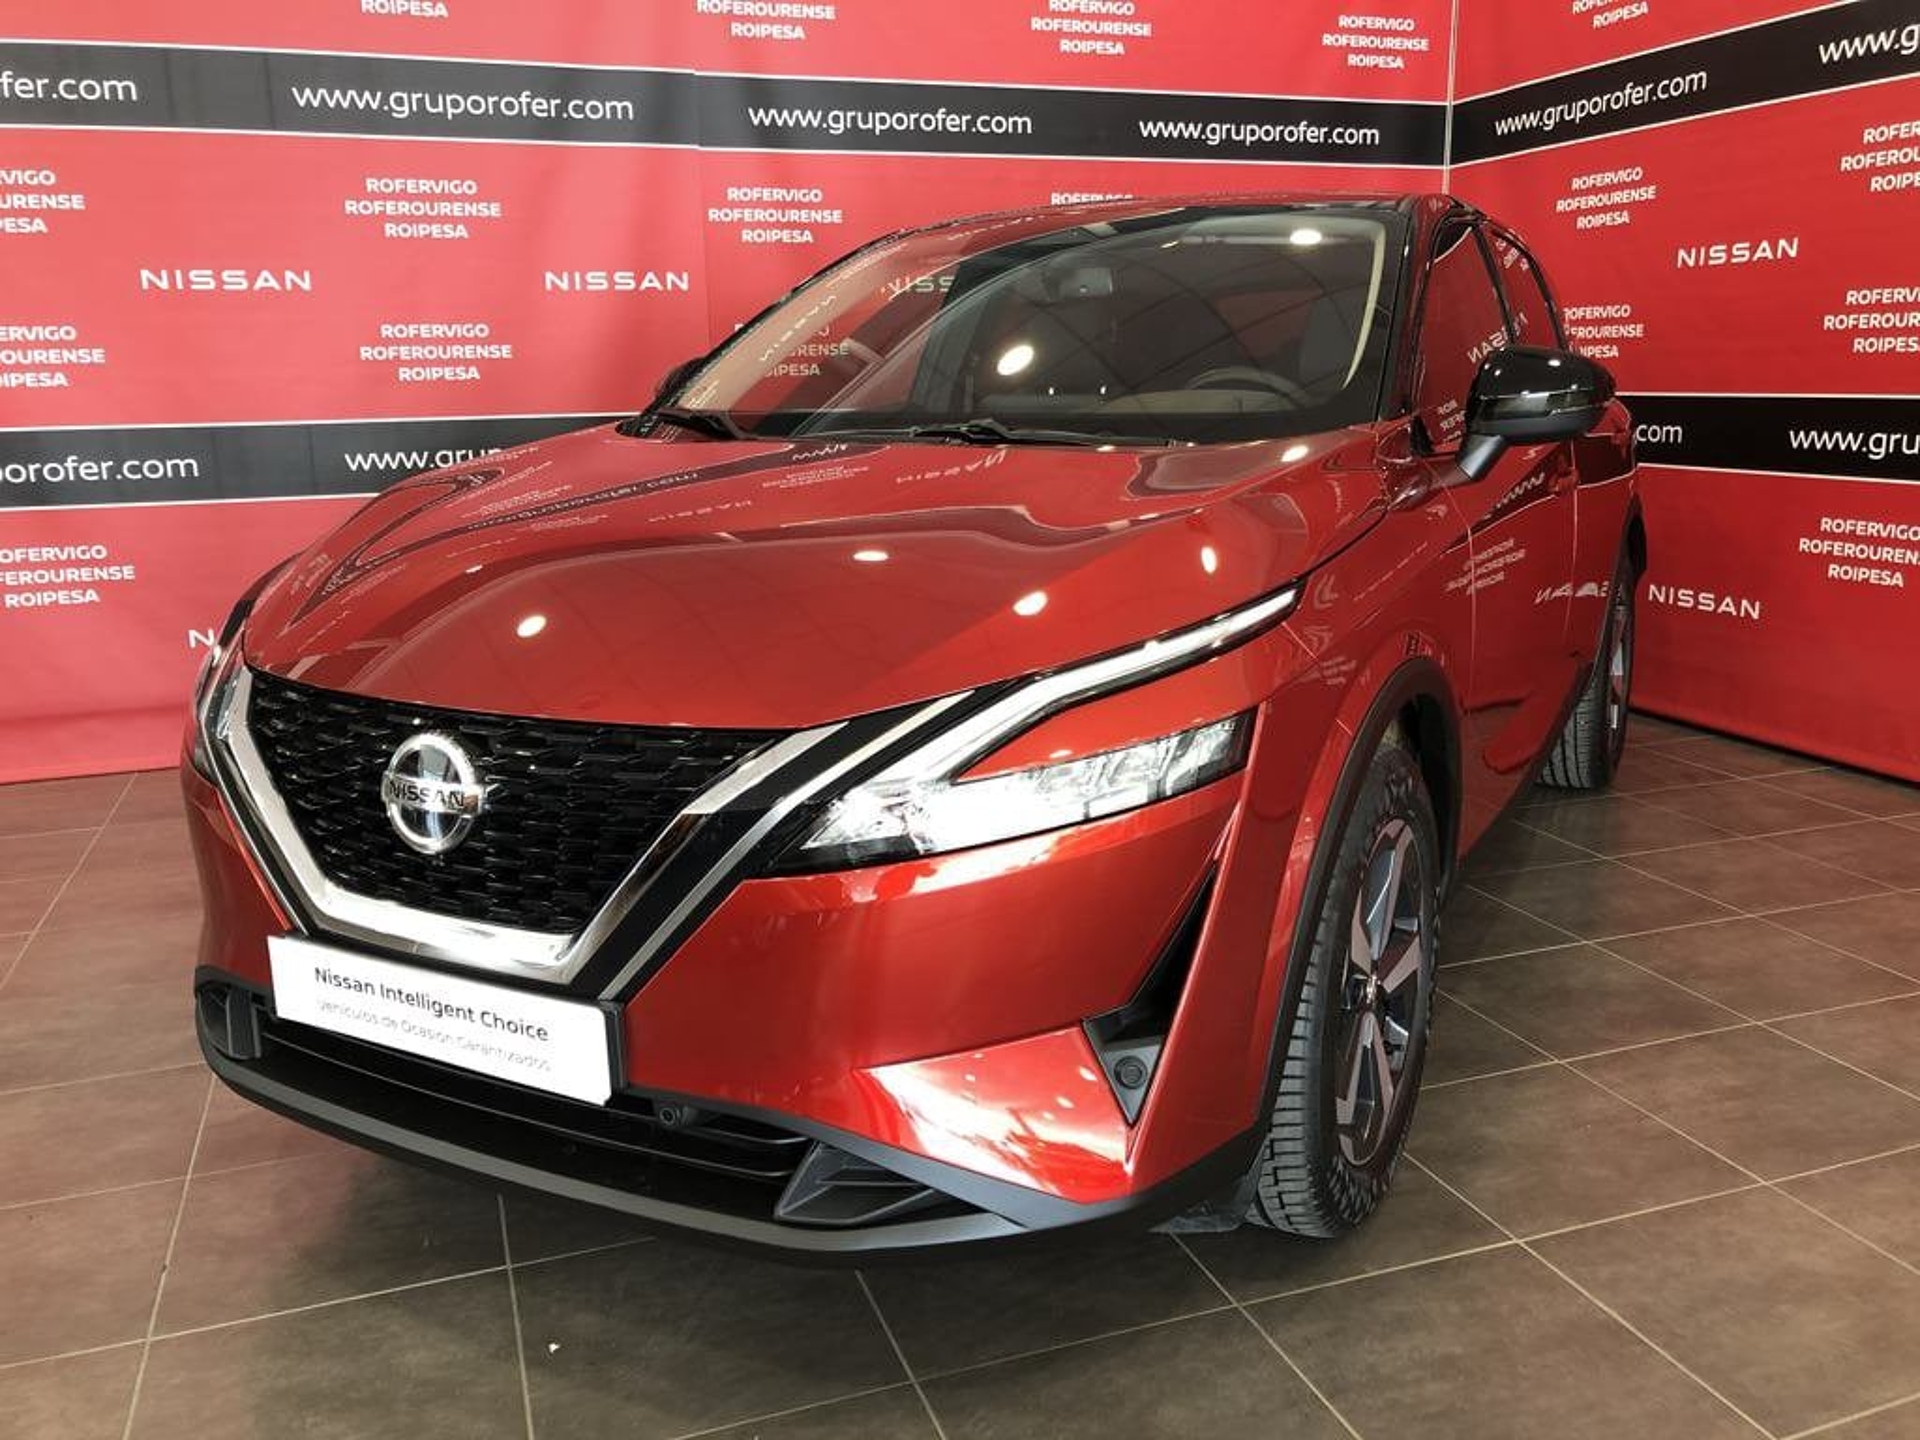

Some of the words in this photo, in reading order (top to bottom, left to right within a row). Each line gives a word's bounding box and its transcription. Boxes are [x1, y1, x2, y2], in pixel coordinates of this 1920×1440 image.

[360, 0, 448, 17] ROIPESA
[697, 0, 835, 20] ROFEROURENSE
[1050, 0, 1134, 15] ROFERVIGO
[1593, 1, 1649, 30] ROIPESA
[731, 22, 805, 39] ROIPESA
[1031, 17, 1151, 36] ROFEROURENSE
[1338, 14, 1414, 31] ROFERVIGO
[1060, 39, 1125, 55] ROIPESA
[1322, 33, 1429, 51] ROFEROURENSE
[1347, 54, 1404, 68] ROIPESA
[292, 83, 634, 121] www.gruporofer.com
[1494, 70, 1707, 137] www.gruporofer.com
[748, 105, 1032, 136] www.gruporofer.com
[1139, 121, 1379, 146] www.gruporofer.com
[0, 170, 56, 185] VIGO
[366, 177, 477, 195] ROFERVIGO
[1571, 166, 1643, 191] ROFERVIGO
[727, 186, 823, 203] ROFERVIGO
[1556, 185, 1656, 213] ROFEROURENSE
[344, 199, 501, 218] ROFEROURENSE
[708, 207, 842, 224] ROFEROURENSE
[0, 217, 48, 233] ESA
[1576, 209, 1630, 231] ROIPESA
[384, 221, 468, 239] ROIPESA
[741, 228, 814, 244] ROIPESA
[1677, 236, 1799, 269] NISSAN
[140, 267, 312, 291] NISSAN
[544, 270, 689, 292] NISSAN
[380, 322, 489, 339] ROFERVIGO
[360, 343, 512, 361] ROFEROURENSE
[1853, 336, 1920, 354] ROIPES
[0, 372, 69, 388] IPESA
[398, 364, 480, 382] ROIPESA
[0, 455, 200, 484] orofer.com
[1820, 517, 1920, 541] ROFERVIGO
[1799, 537, 1920, 566] ROFEROUREN
[1828, 563, 1904, 588] ROIPESA
[5, 588, 101, 608] ROIPESA
[1648, 584, 1761, 620] NISSAN
[389, 780, 465, 808] NISSAN
[315, 966, 376, 996] Nissan
[380, 983, 476, 1024] Intelligent
[481, 1009, 549, 1042] Choice
